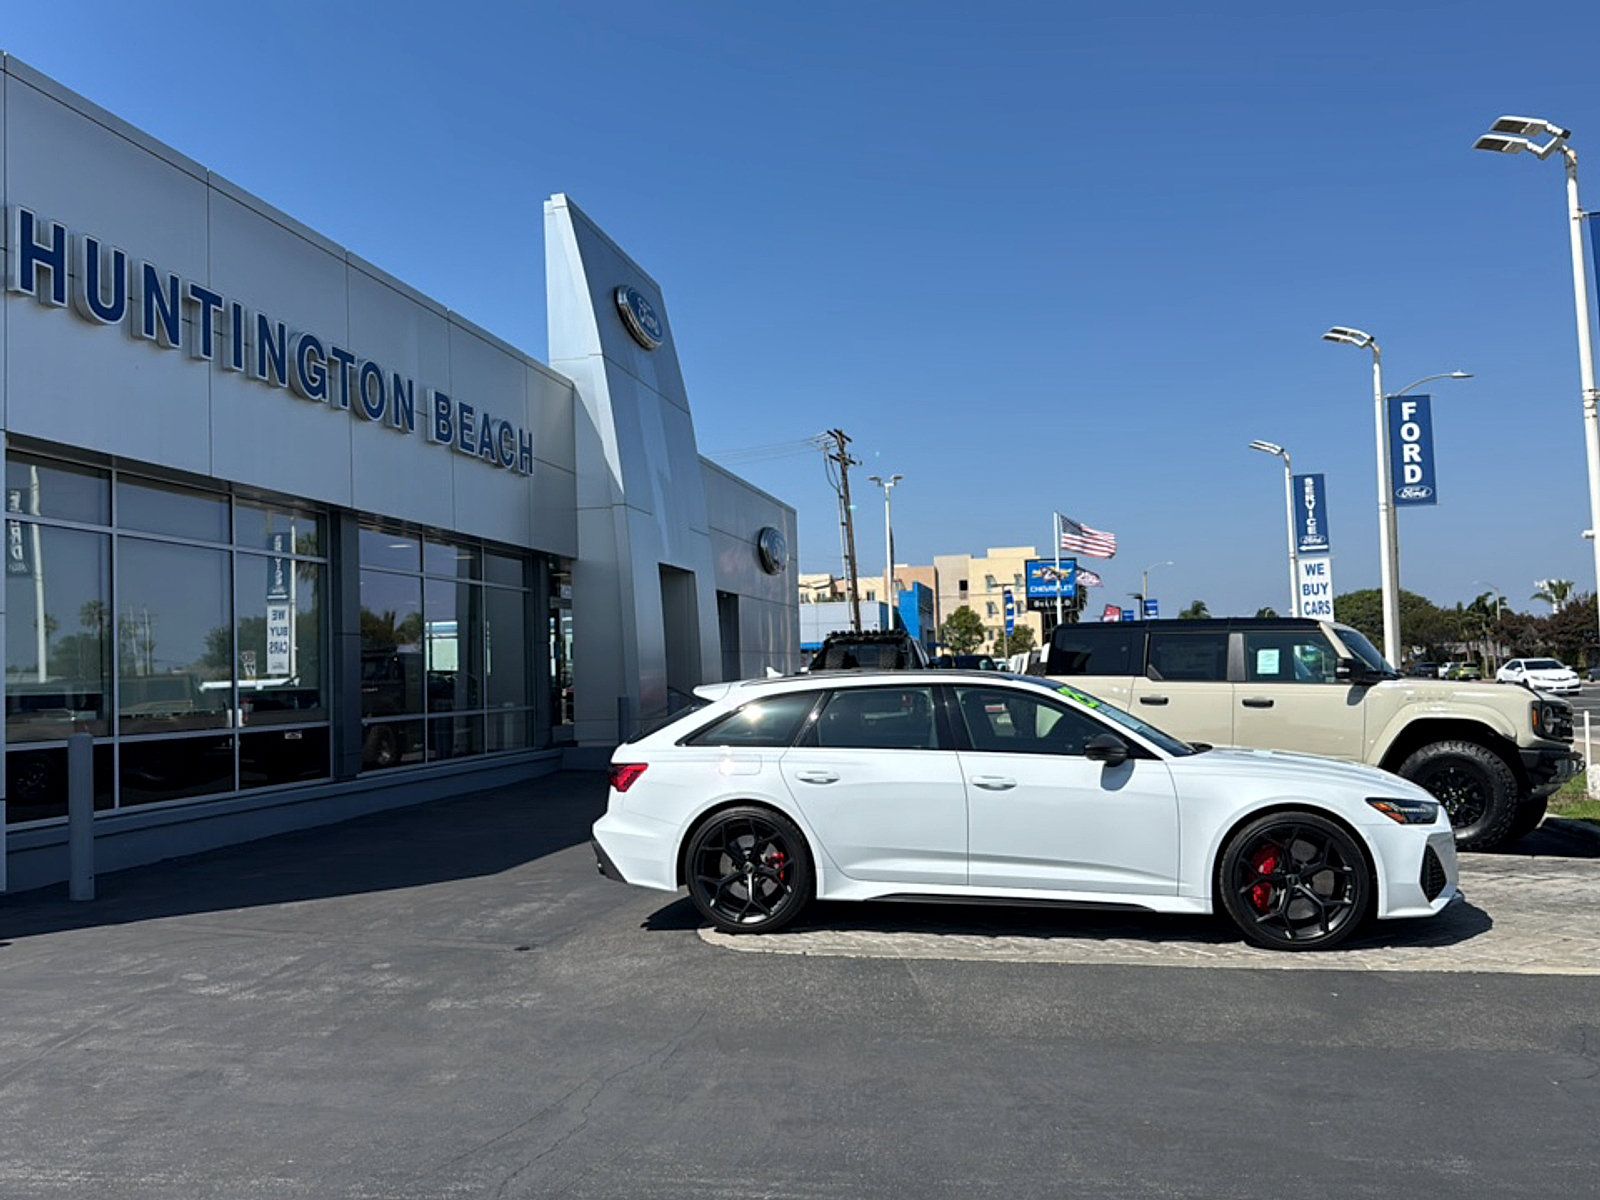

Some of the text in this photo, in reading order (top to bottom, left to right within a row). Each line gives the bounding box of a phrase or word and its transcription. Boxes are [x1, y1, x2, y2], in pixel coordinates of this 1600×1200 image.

[14, 205, 535, 477] HUNTINGTON BEACH
[1400, 401, 1423, 484] FORD
[1305, 563, 1325, 576] WE
[1302, 582, 1329, 596] BUY
[1303, 600, 1331, 616] CARS
